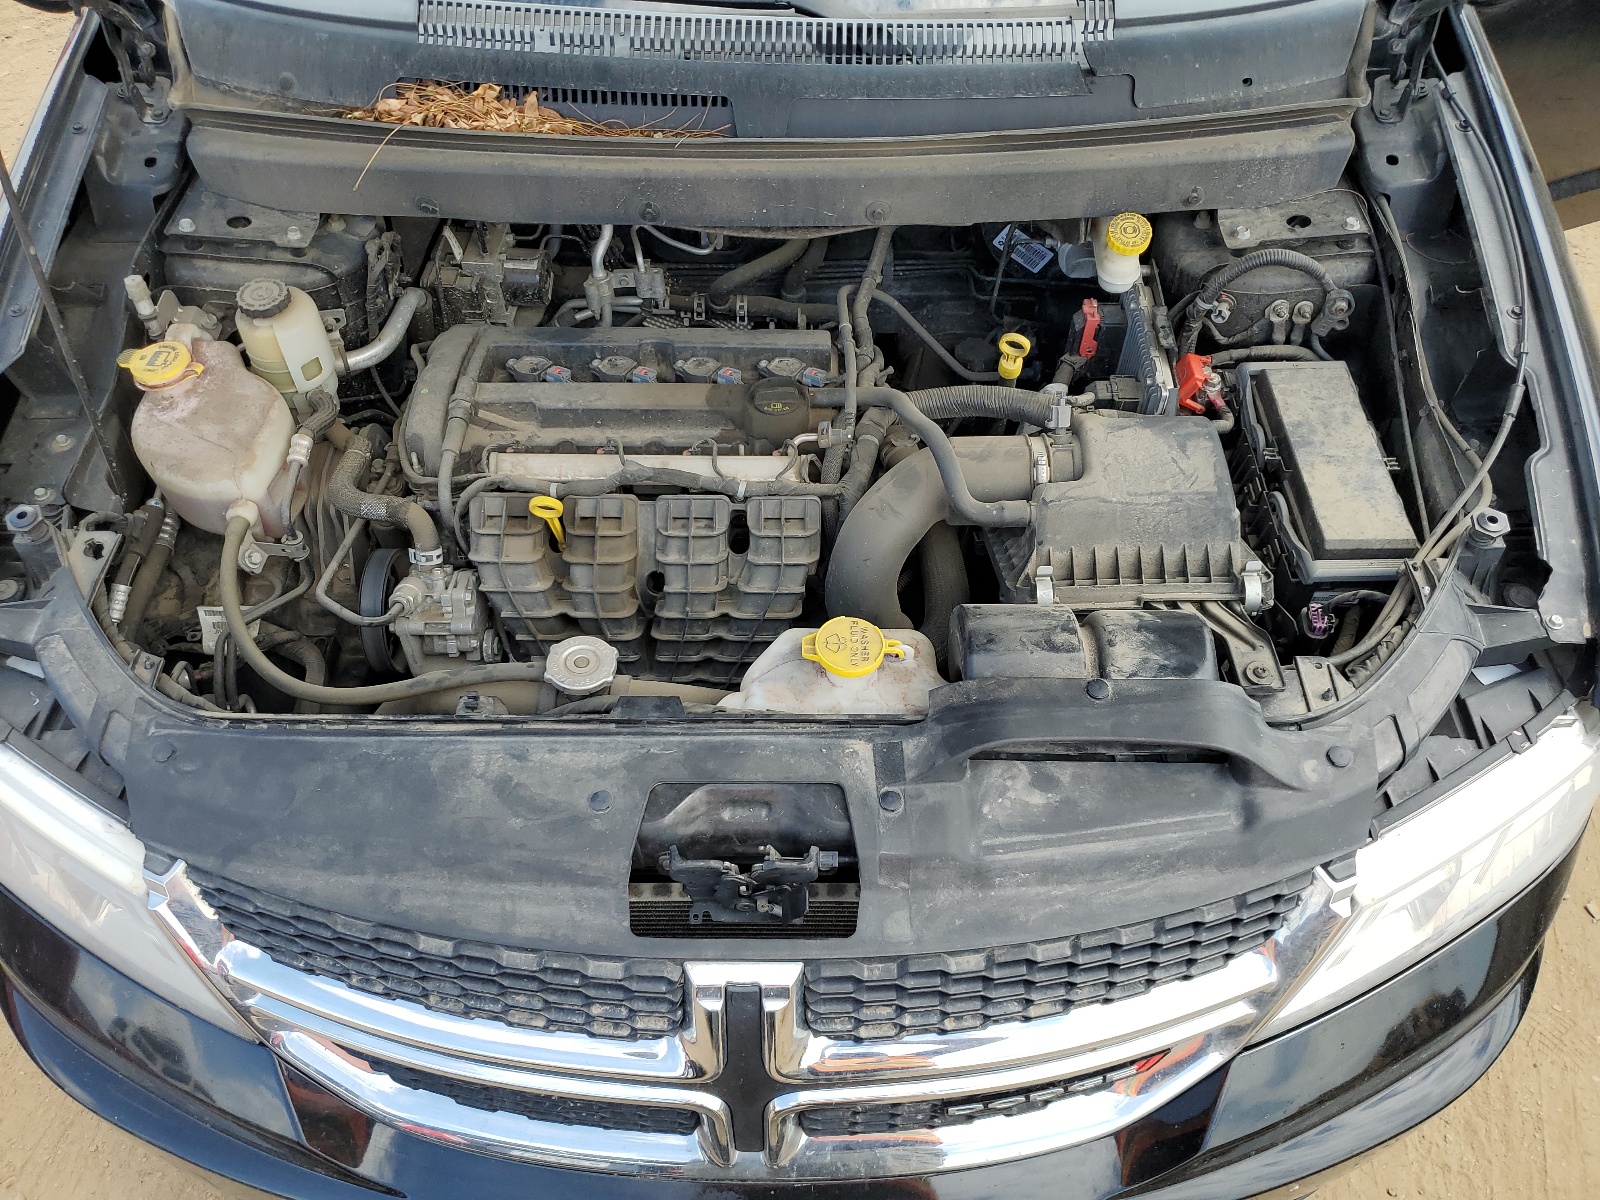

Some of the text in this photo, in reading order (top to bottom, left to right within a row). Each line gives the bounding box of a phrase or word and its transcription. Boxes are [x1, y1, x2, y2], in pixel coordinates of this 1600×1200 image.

[849, 620, 859, 667] FLUID ONLY
[860, 626, 870, 662] WASHER
